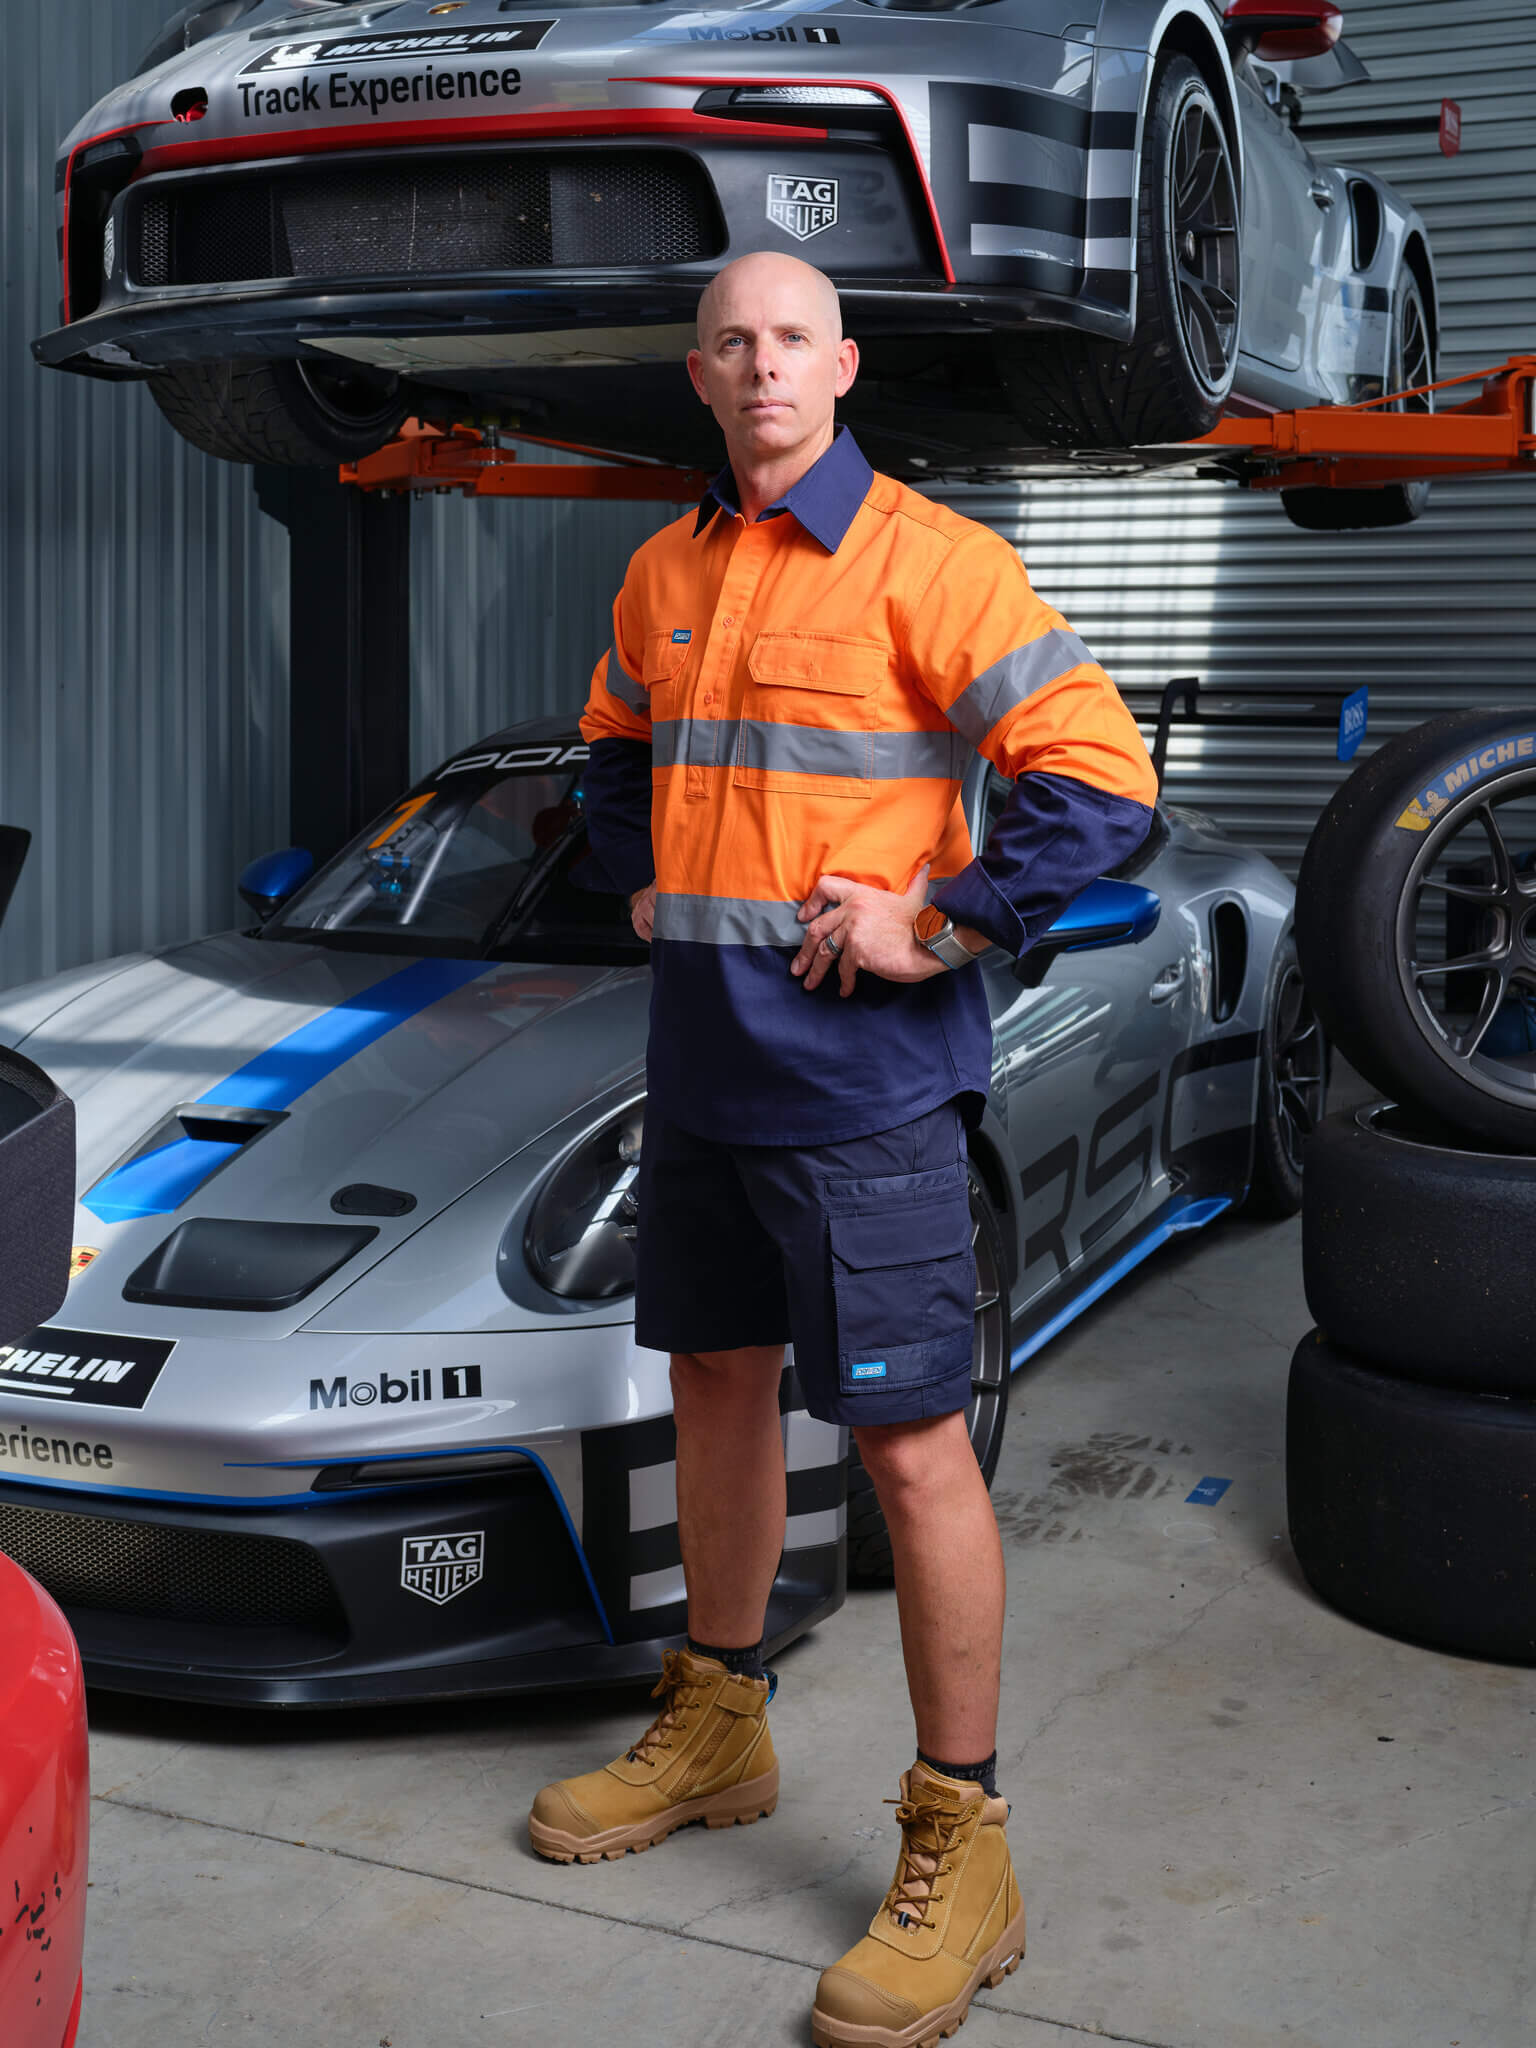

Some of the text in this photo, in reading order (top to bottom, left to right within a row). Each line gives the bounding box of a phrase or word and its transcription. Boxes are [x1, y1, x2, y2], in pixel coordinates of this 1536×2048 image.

[322, 30, 523, 57] MICHELIN
[687, 26, 797, 42] Mobil
[237, 65, 521, 117] Track Experience
[774, 179, 832, 203] TAG
[772, 203, 834, 236] HEUER
[310, 1369, 432, 1411] Mobil
[409, 1537, 477, 1563] TAG
[407, 1564, 478, 1599] HEUER
